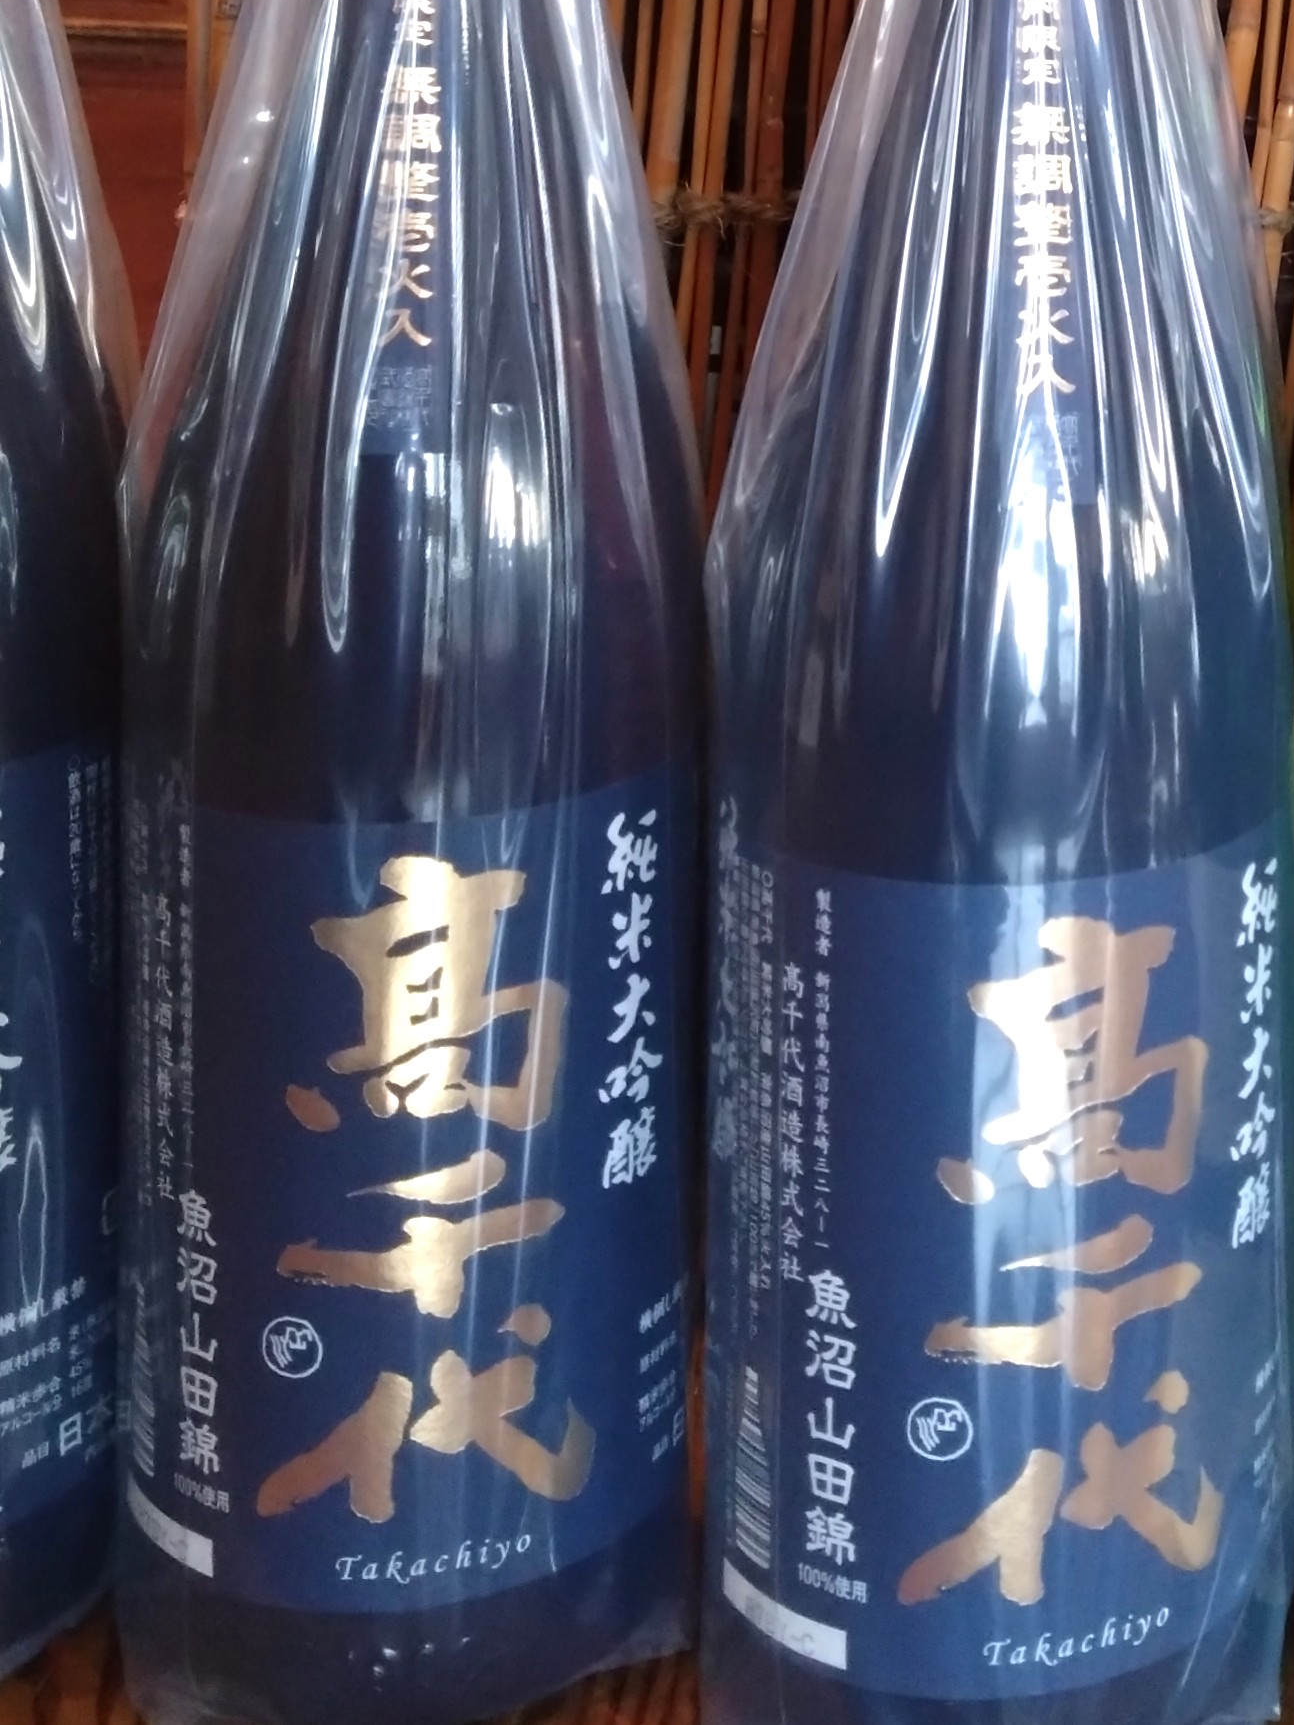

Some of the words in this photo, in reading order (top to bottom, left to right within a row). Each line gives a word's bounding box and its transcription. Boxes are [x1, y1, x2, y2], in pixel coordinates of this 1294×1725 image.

[598, 808, 665, 1191] 純米大吟醸
[782, 961, 804, 1283] 高千代酒造株式会社
[1231, 859, 1280, 1250] 純米大吟醸
[176, 1188, 221, 1474] 魚沼山田錦
[256, 855, 594, 1523] 高千代
[897, 915, 1222, 1605] 高千代
[334, 1528, 534, 1585] Takachiyo
[805, 1269, 858, 1566] 魚沼山田錦
[798, 1563, 868, 1604] 100%使用
[983, 1605, 1172, 1671] Takachiyo
